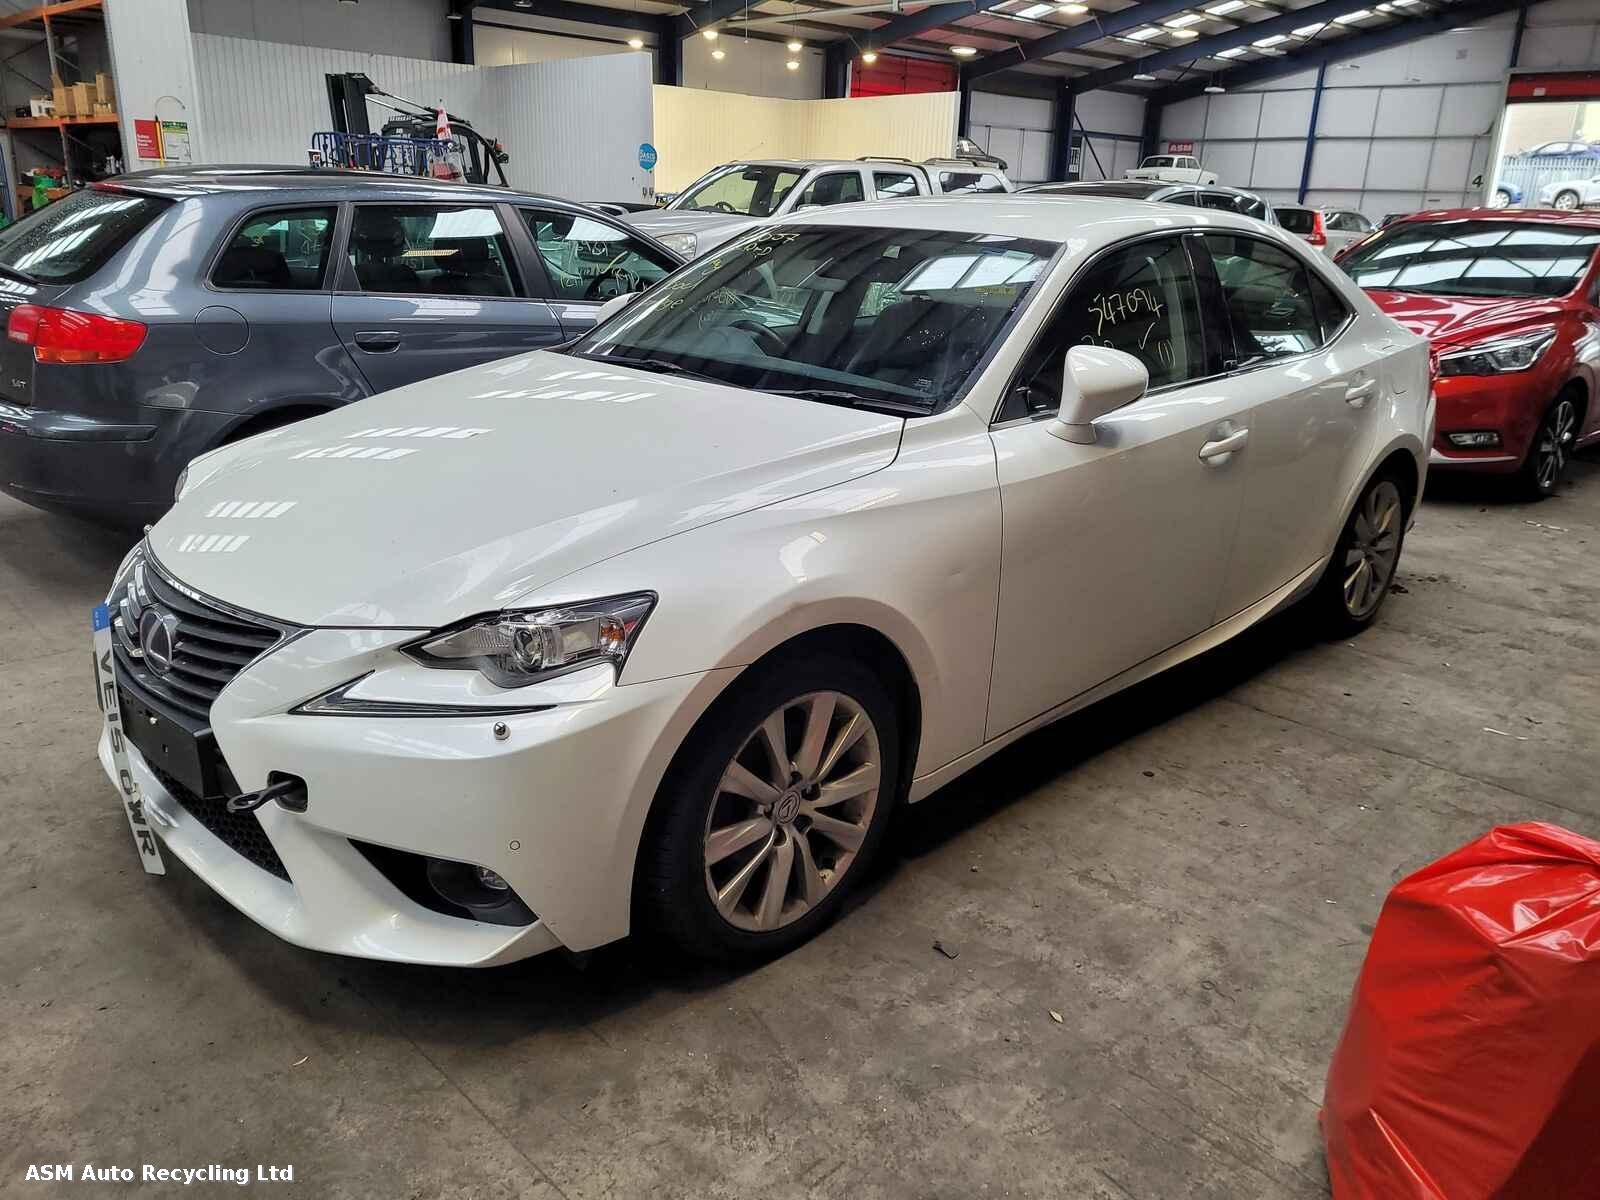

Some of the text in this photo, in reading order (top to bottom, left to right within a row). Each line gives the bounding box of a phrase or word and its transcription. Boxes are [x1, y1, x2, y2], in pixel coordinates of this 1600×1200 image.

[1170, 144, 1192, 152] ASM
[1472, 175, 1484, 187] 4
[1088, 288, 1165, 337] 547094
